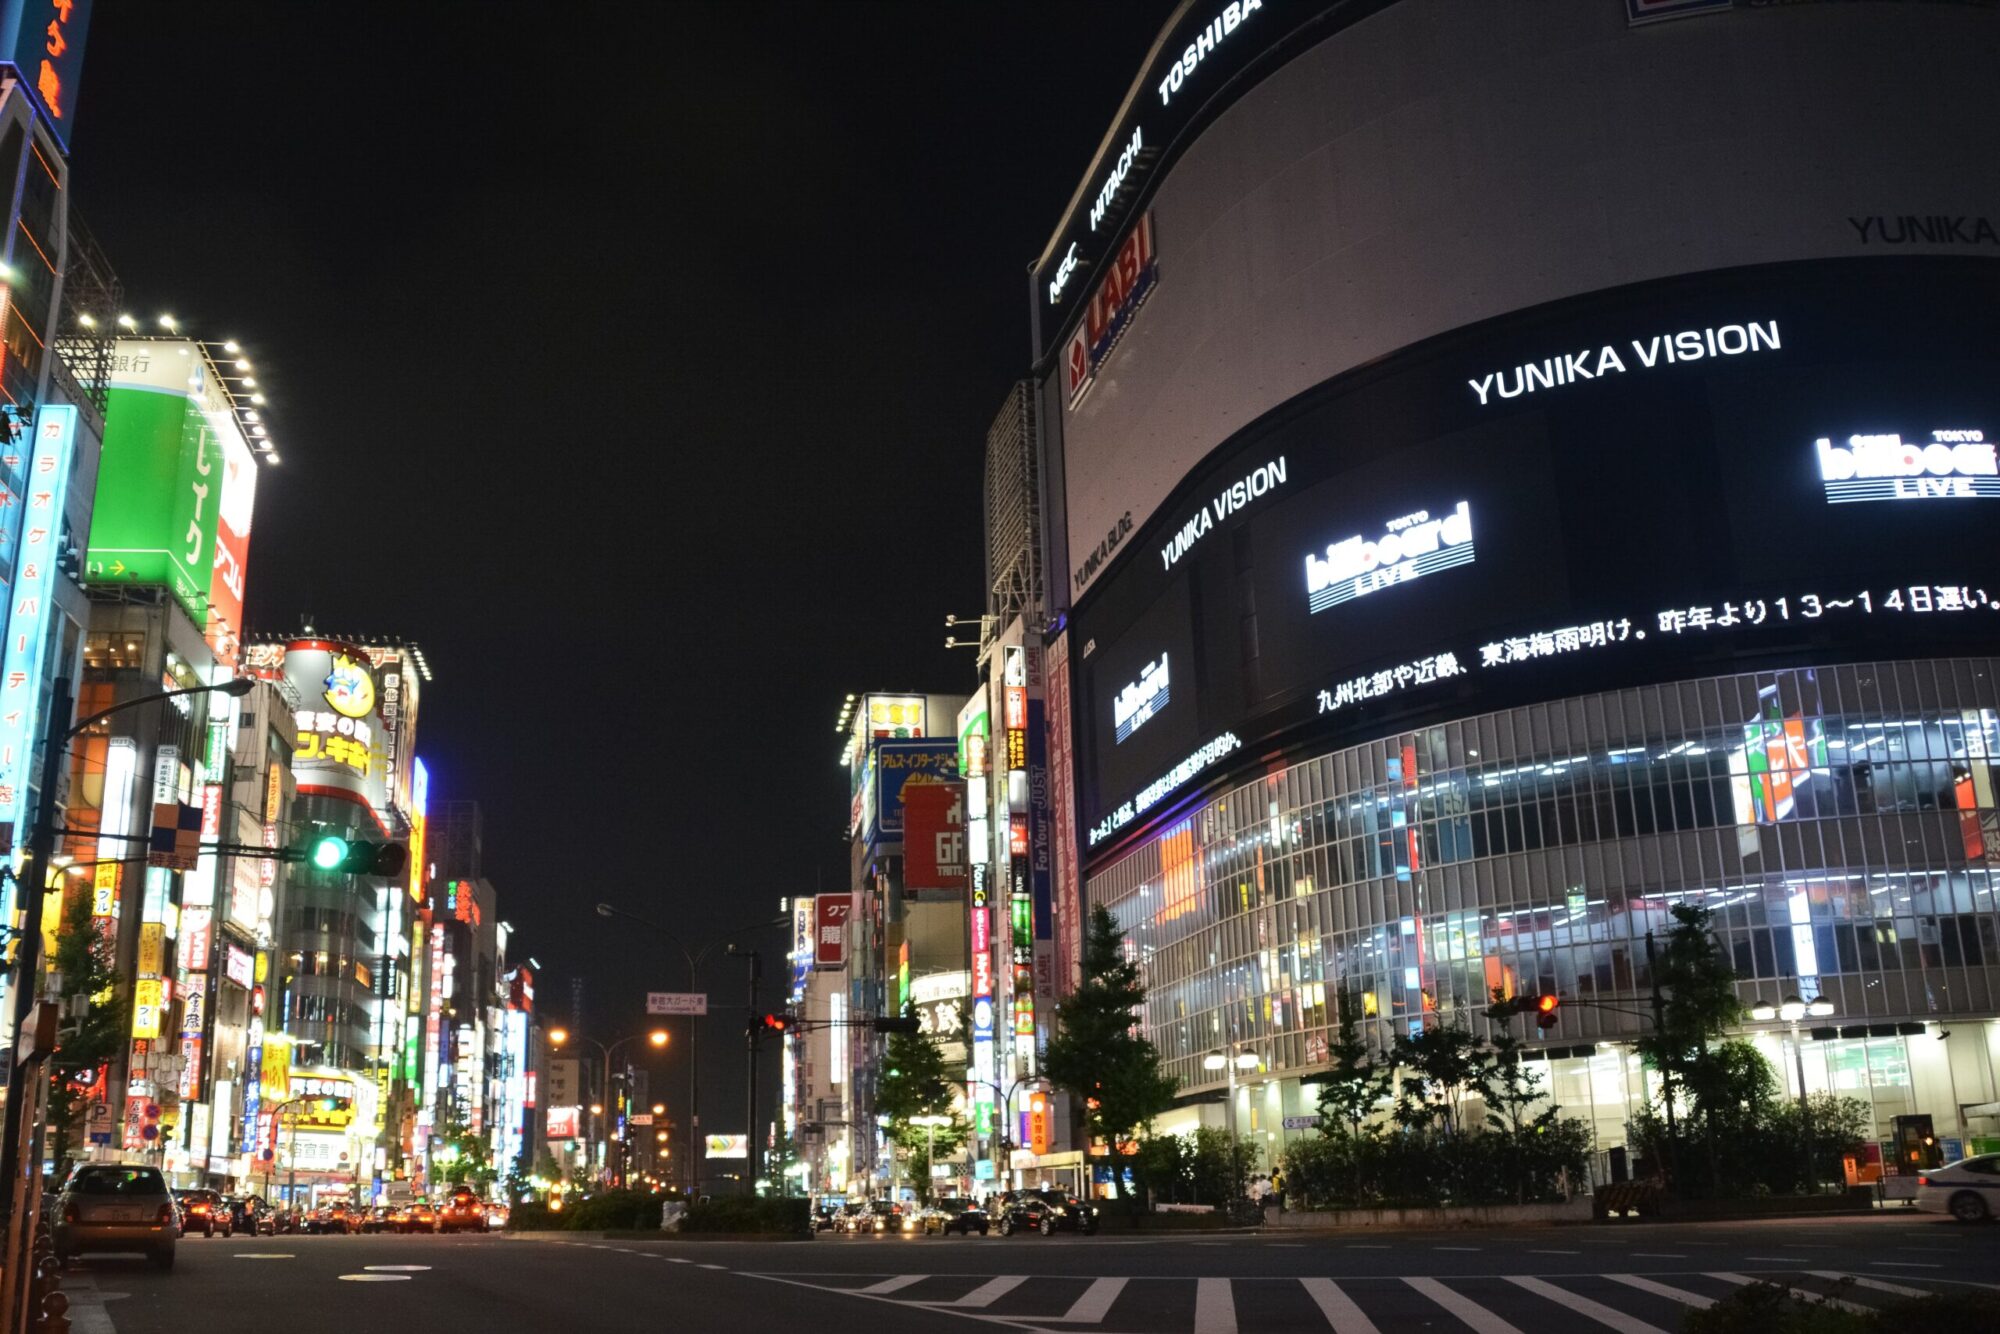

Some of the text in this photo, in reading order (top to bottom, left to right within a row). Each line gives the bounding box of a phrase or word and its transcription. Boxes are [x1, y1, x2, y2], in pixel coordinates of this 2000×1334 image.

[1158, 0, 1265, 106] TOSHIBA
[1089, 126, 1143, 232] HITACHI
[1848, 216, 2000, 244] YUNIKA
[1049, 241, 1078, 305] NEC
[1086, 212, 1148, 350] LABI
[1469, 319, 1782, 405] YUNIKA VISION
[1816, 434, 2000, 481] billboar
[1932, 430, 1983, 442] TOKYO
[1160, 455, 1287, 571] YUNIKA VISION
[1894, 478, 1978, 499] LIVE
[1073, 539, 1108, 592] YUNIKA
[1305, 500, 1473, 594] billboard
[1355, 557, 1420, 597] LIVE
[95, 1105, 107, 1118] P
